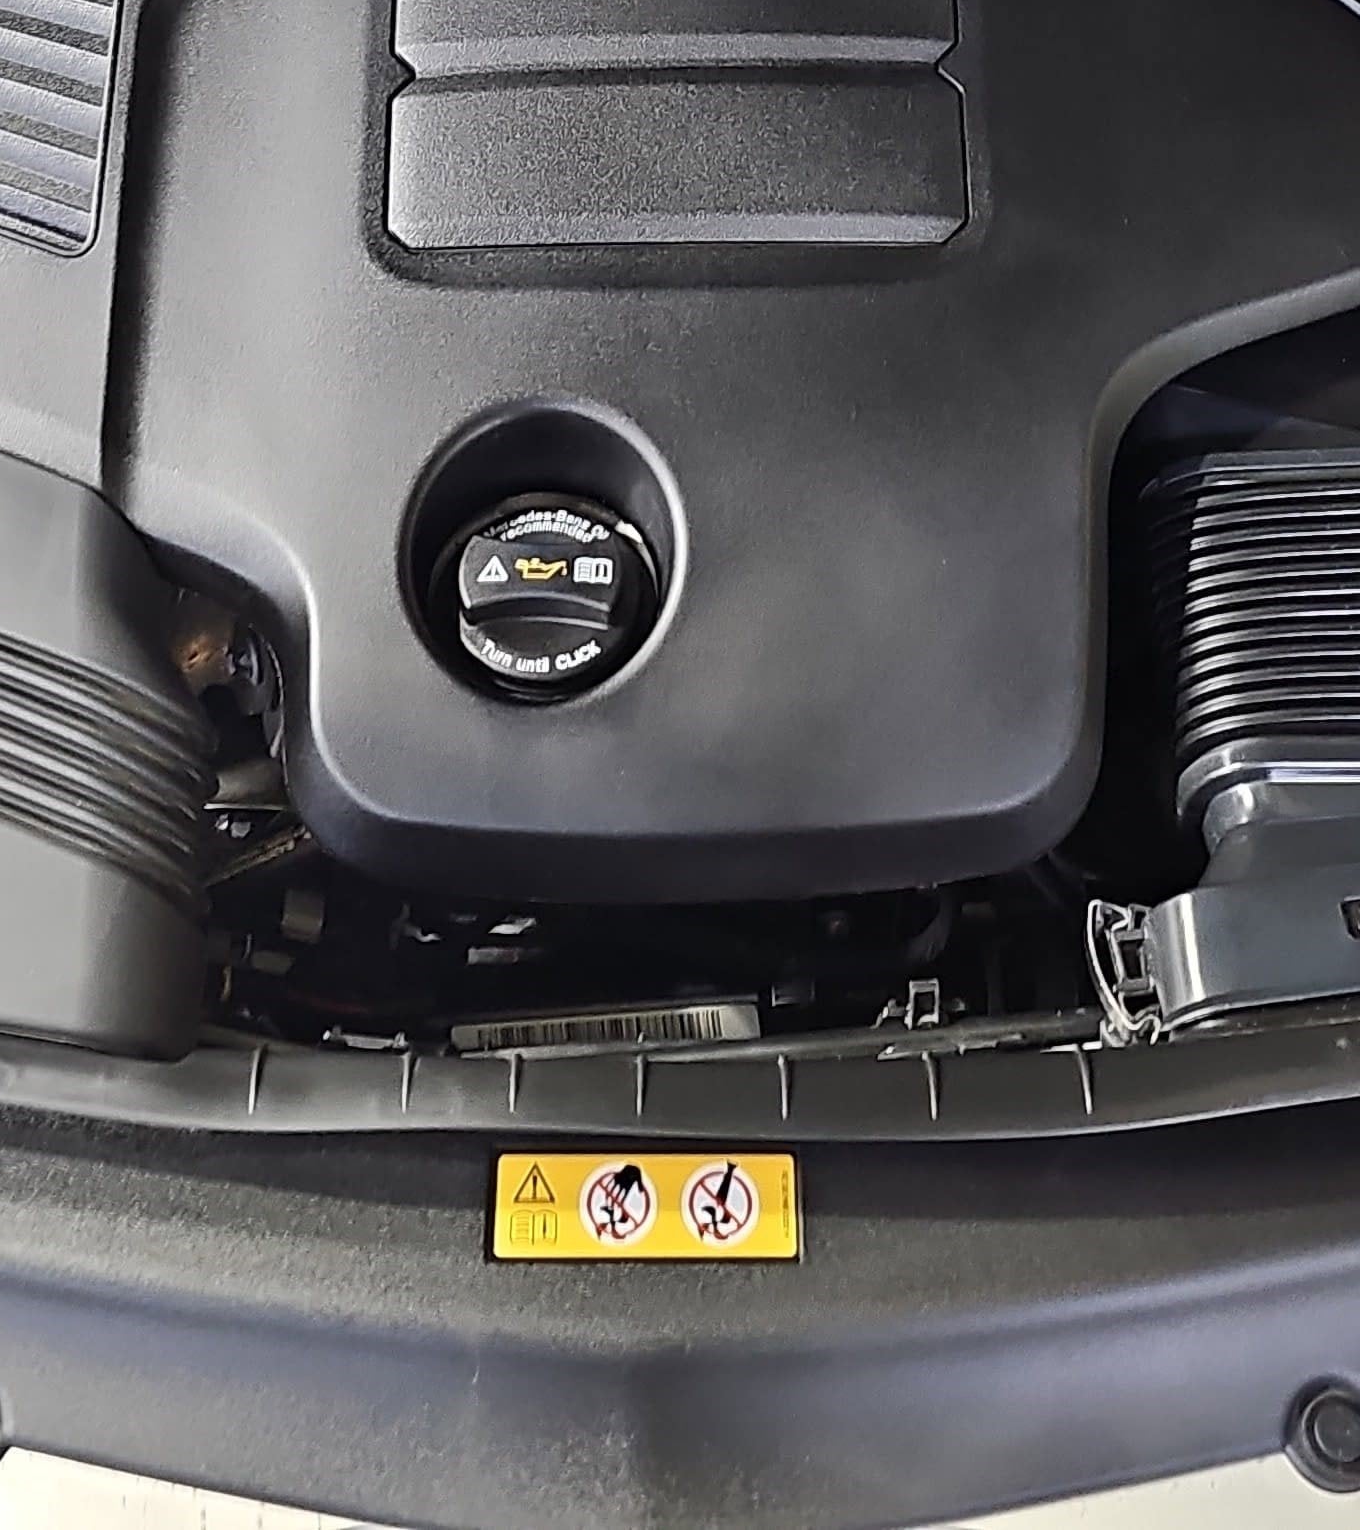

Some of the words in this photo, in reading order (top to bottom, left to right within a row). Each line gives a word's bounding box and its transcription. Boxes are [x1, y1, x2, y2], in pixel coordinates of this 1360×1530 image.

[480, 637, 513, 668] Turn
[515, 655, 550, 673] until
[555, 639, 602, 671] CLICK
